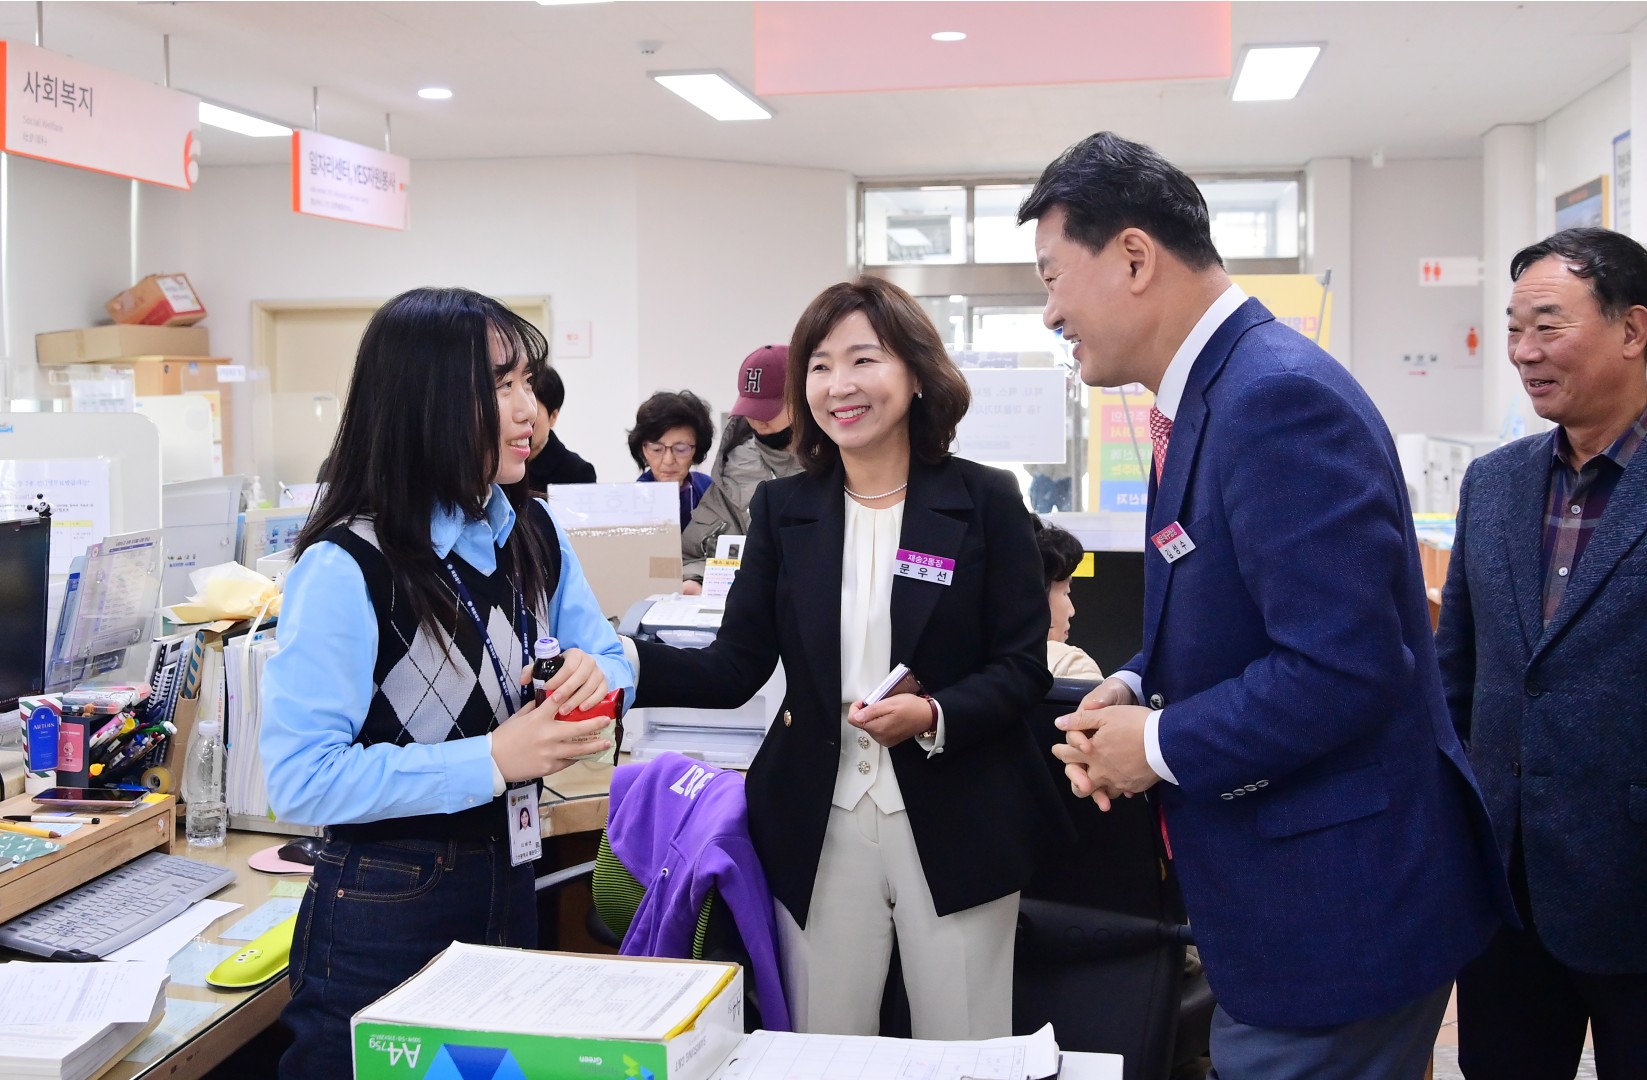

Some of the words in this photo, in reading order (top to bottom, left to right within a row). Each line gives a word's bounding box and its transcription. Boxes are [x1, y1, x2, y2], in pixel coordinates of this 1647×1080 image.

[23, 70, 94, 118] 사회복지
[745, 368, 762, 392] H
[907, 553, 944, 568] 재송2동장
[368, 1037, 390, 1052] 75g
[389, 1042, 422, 1069] A4
[579, 1055, 603, 1066] Green
